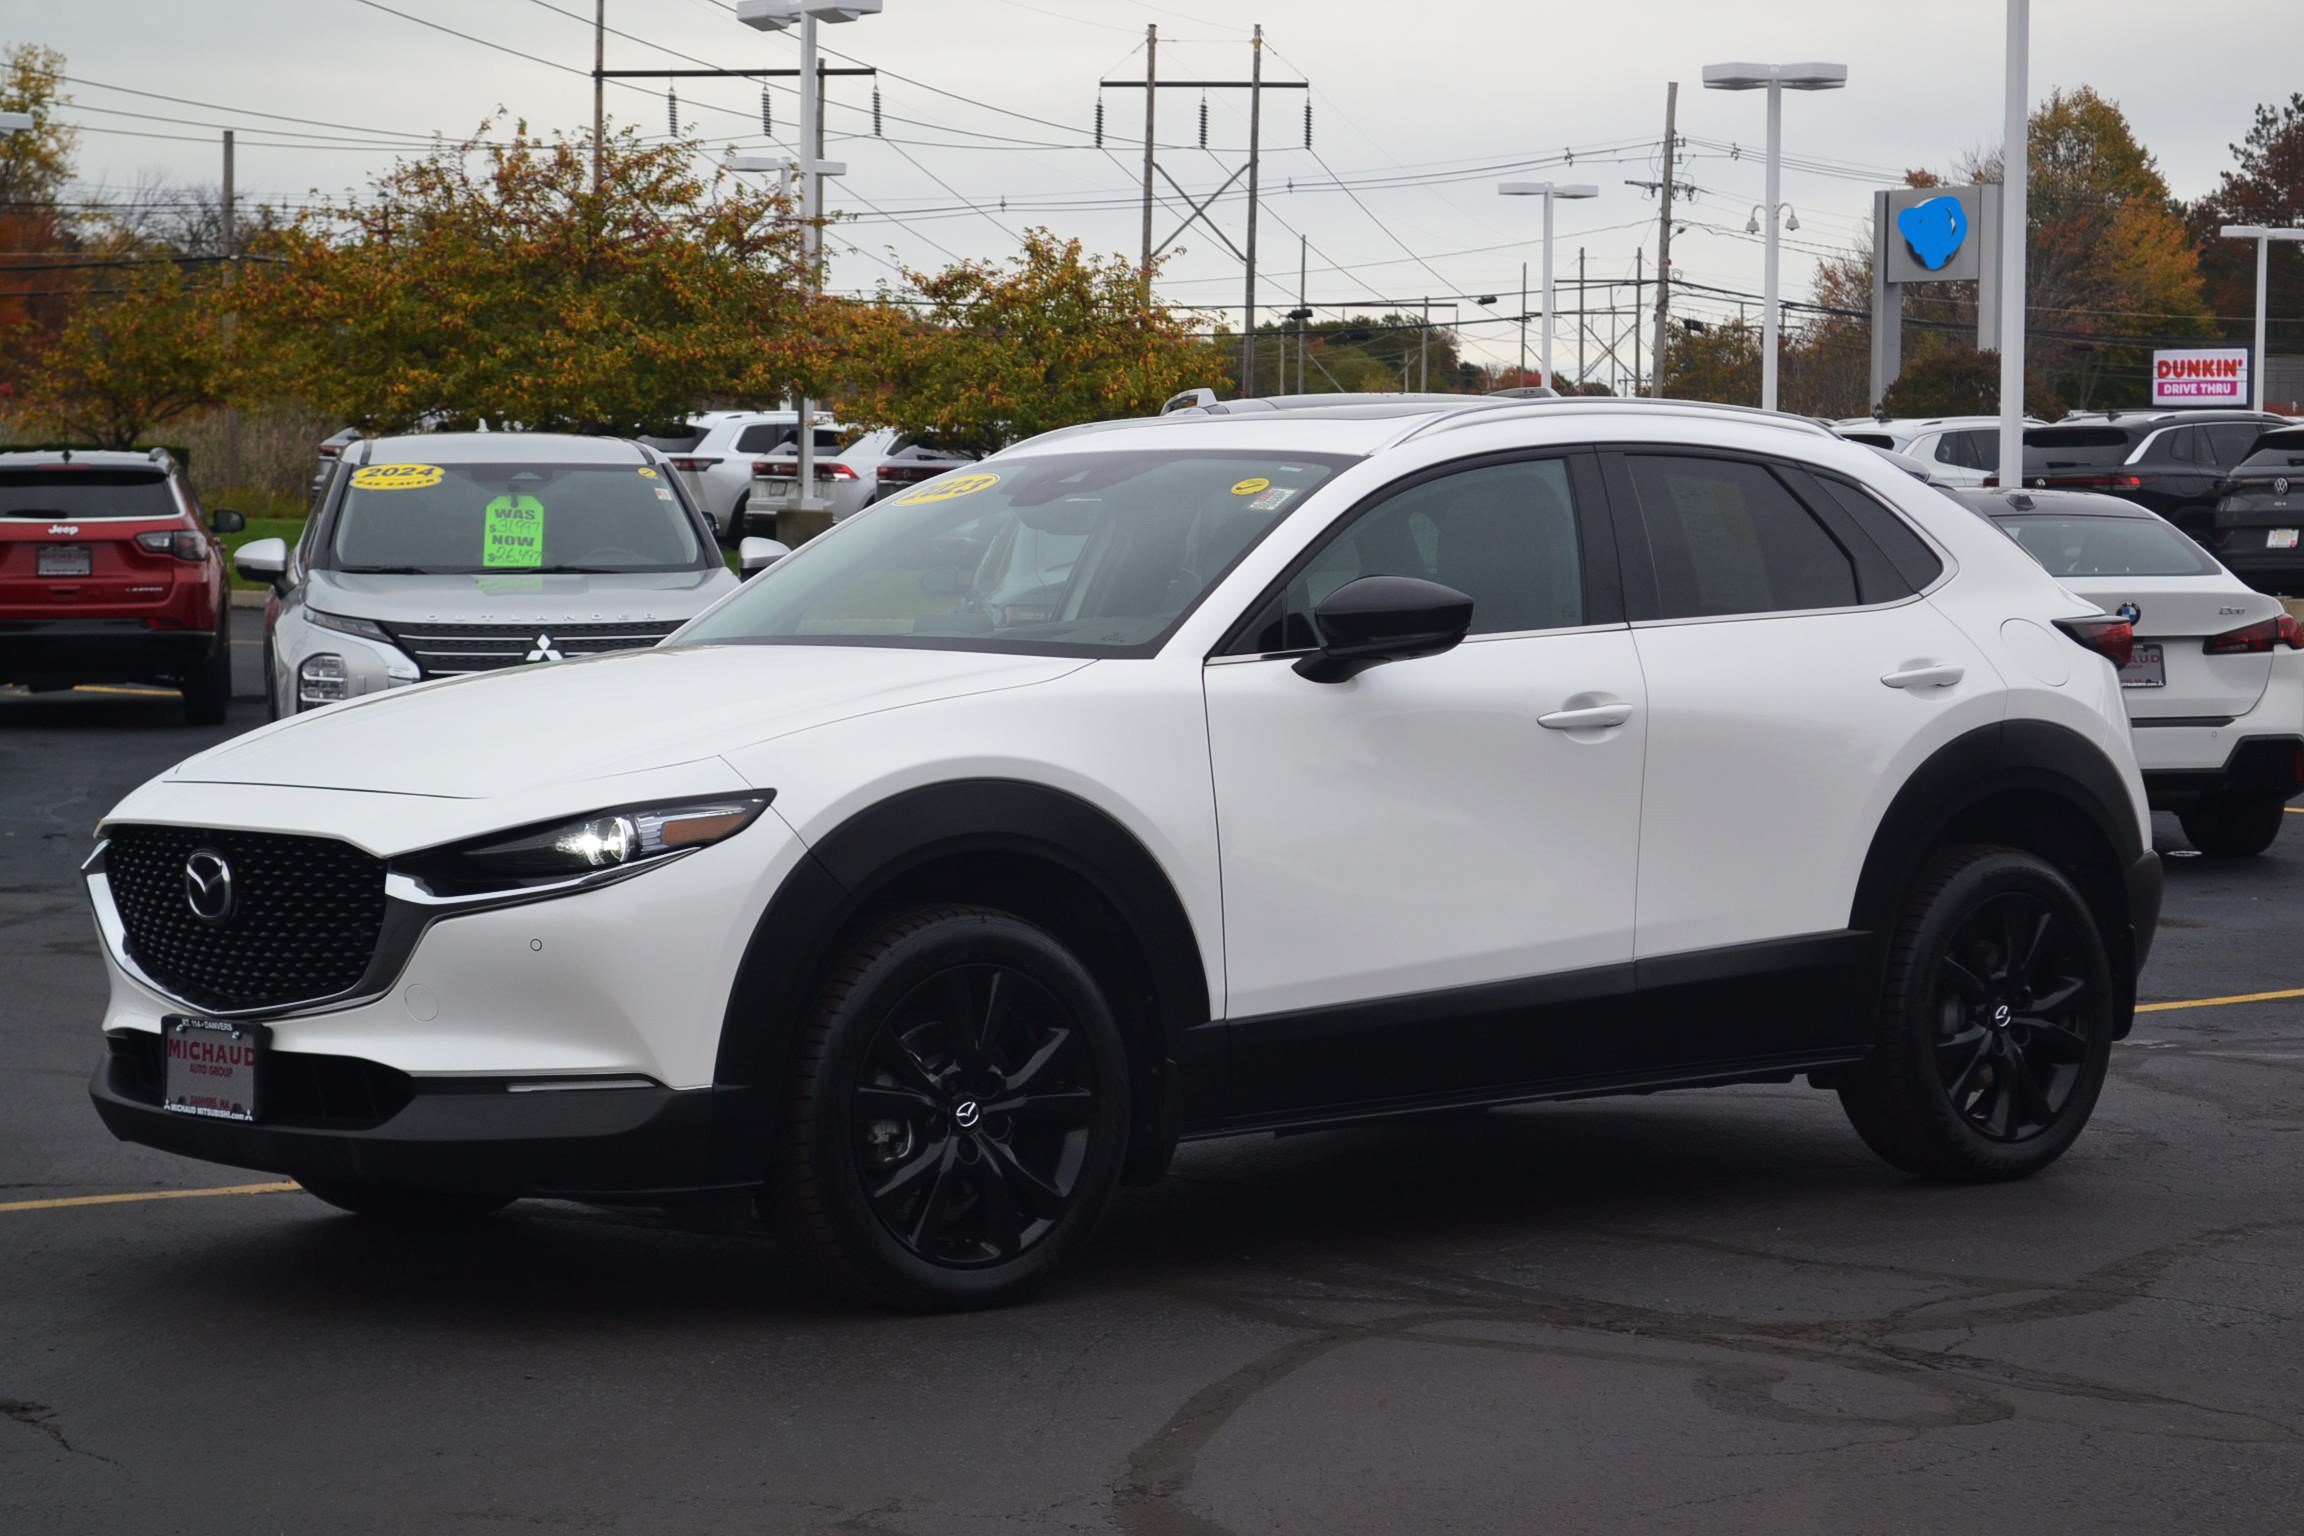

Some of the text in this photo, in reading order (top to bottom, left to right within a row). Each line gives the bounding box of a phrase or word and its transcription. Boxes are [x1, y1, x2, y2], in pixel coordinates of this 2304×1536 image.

[2157, 359, 2244, 378] DUNKIN'
[2164, 383, 2231, 395] DRIVE THRU
[363, 466, 435, 478] 2024
[494, 509, 536, 520] WAS
[47, 524, 79, 536] Jeep
[491, 535, 535, 547] NOW
[426, 612, 656, 622] OUTLANDER
[168, 1039, 255, 1067] MICHAUD
[189, 1063, 233, 1078] AUTO GROUP
